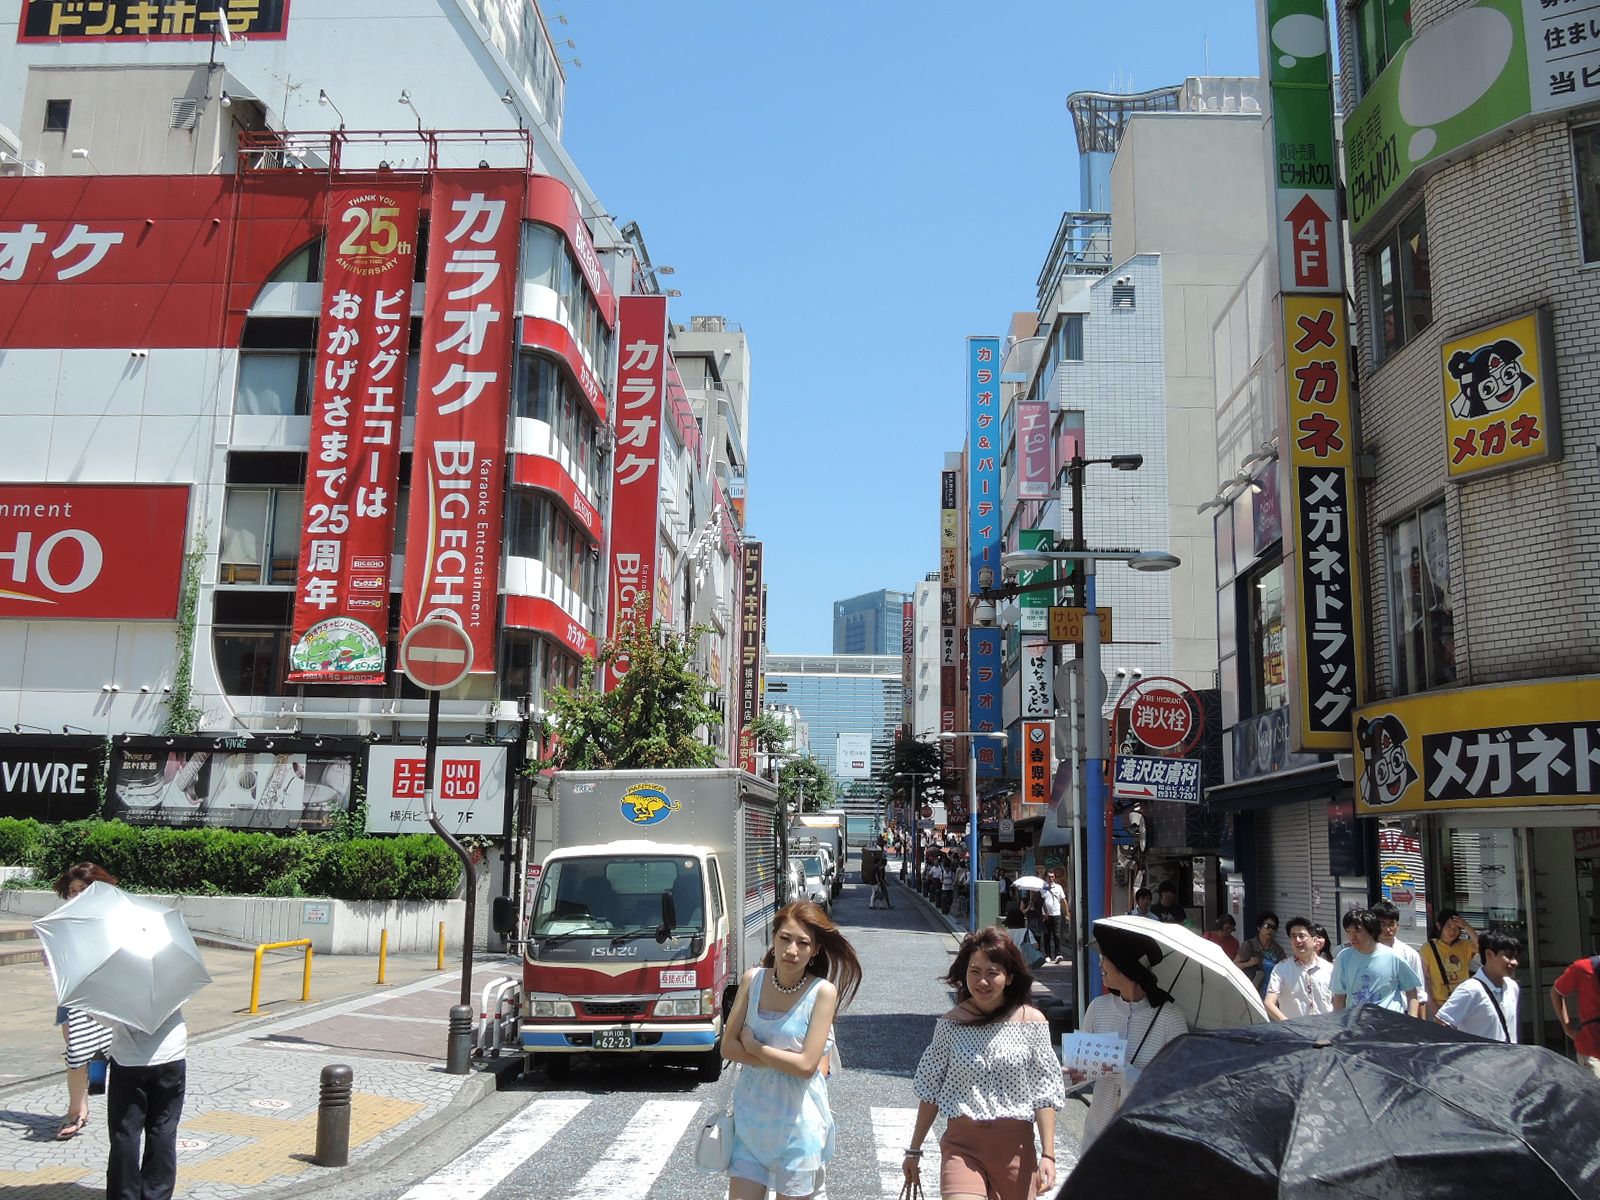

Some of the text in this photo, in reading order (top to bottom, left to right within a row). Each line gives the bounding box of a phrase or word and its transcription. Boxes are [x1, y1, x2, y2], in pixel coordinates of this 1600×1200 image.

[348, 195, 396, 207] THANK YOU
[339, 207, 411, 255] 25th
[0, 223, 124, 281] オケ
[336, 257, 398, 276] ANNIVERSARY
[432, 192, 506, 415] カラオケ
[580, 364, 599, 402] カラオケ
[1294, 309, 1344, 458] メガネ
[356, 288, 404, 517] ビッグエコーは
[616, 339, 659, 486] カラオケ
[304, 290, 362, 610] おかげさまで25周年
[1452, 413, 1542, 466] メガネ
[433, 440, 476, 520] BIG
[470, 459, 492, 627] Karaoke Entertainment
[616, 553, 641, 602] BIG
[1304, 471, 1352, 728] メガネドラッグ
[903, 620, 912, 653] カラオケ
[944, 638, 953, 663] かのん
[1031, 656, 1049, 704] はなまる
[1027, 685, 1042, 714] うどん
[1142, 694, 1182, 705] FIRE HYDRANT
[1136, 705, 1187, 732] 消火栓
[225, 738, 247, 750] VIVRE
[1, 761, 88, 794] VIVRE
[398, 763, 426, 777] ユニ
[445, 764, 474, 778] UNI
[1118, 757, 1198, 786] 滝沢皮膚科
[396, 780, 424, 794] クロ
[444, 780, 476, 797] QLO
[457, 811, 474, 823] 7F
[591, 946, 638, 957] ISUZU
[601, 1037, 631, 1048] 62-23
